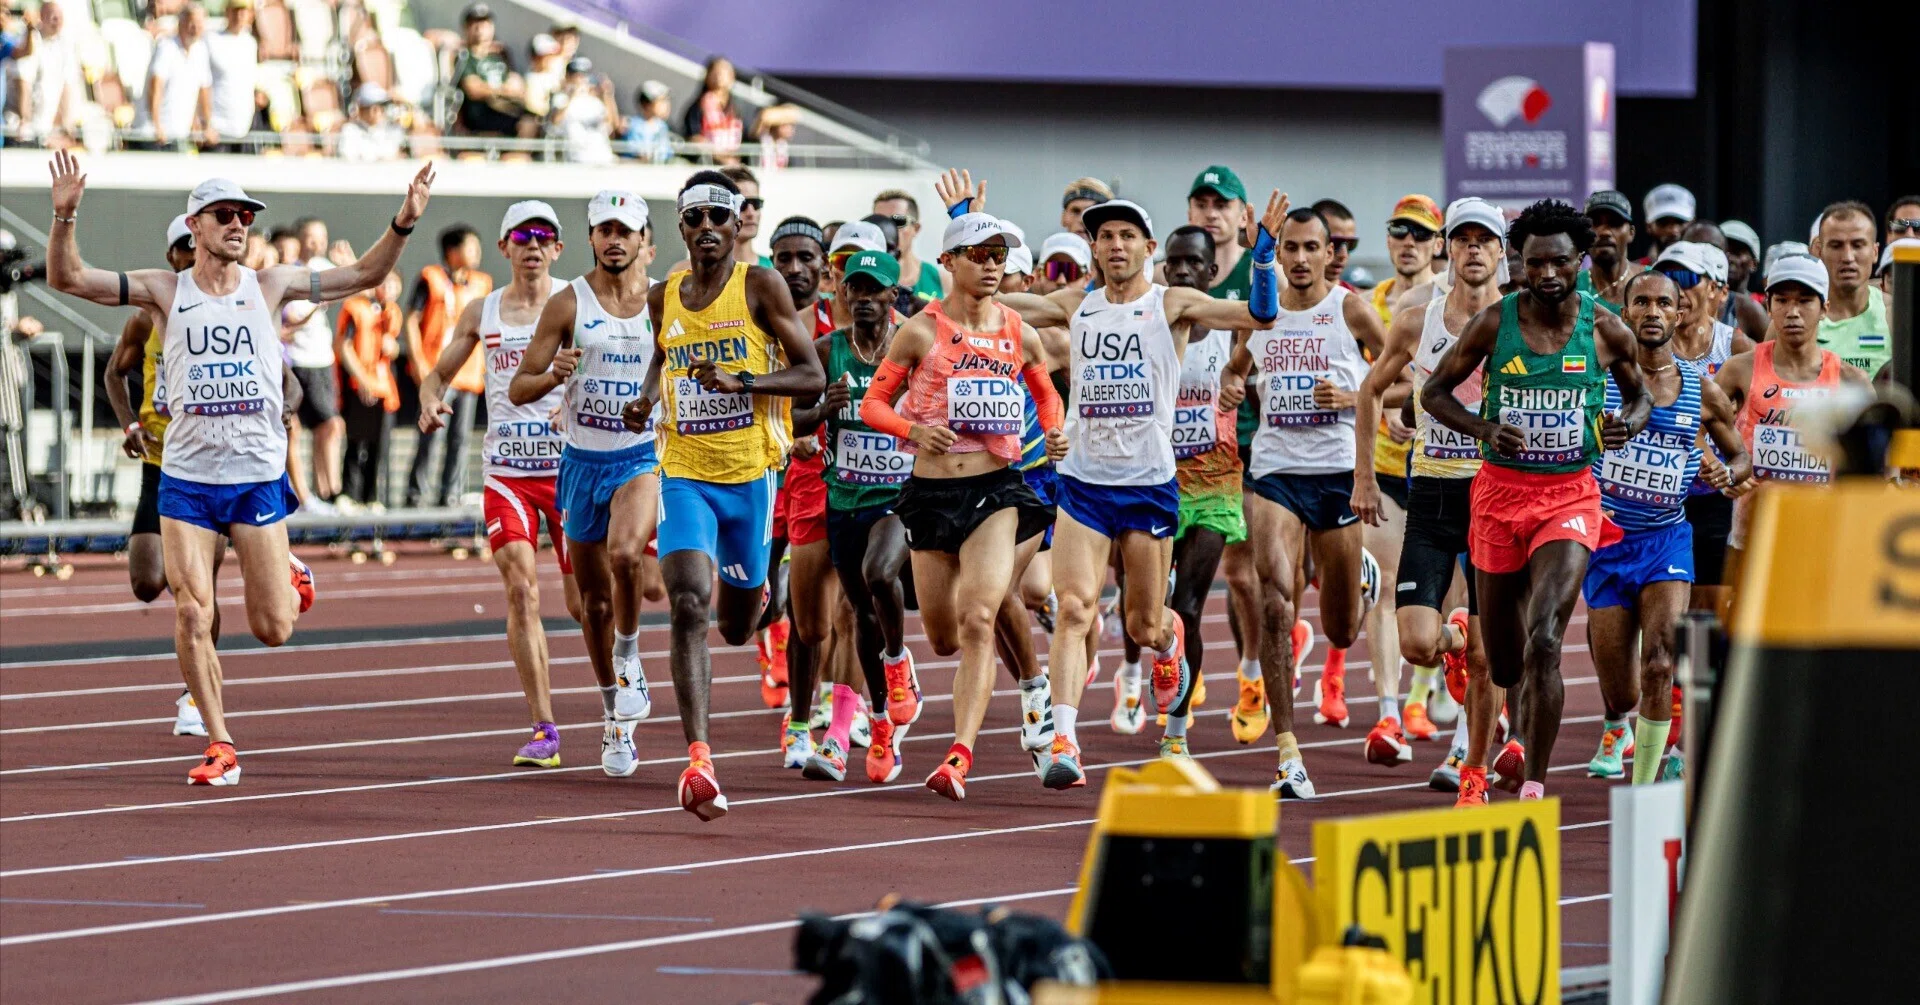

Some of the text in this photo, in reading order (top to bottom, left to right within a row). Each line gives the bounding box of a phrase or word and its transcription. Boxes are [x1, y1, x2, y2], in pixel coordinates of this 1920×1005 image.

[860, 256, 877, 267] IRL
[709, 320, 744, 330] BAUHAUS
[186, 325, 254, 355] USA
[1081, 331, 1143, 361] USA
[1266, 338, 1325, 355] GREAT
[602, 353, 641, 363] ITALIA
[667, 336, 748, 371] SWEDEN
[202, 361, 254, 380] TDK
[953, 353, 1014, 376] JAPAN
[1095, 363, 1145, 381] TDK
[1264, 355, 1329, 372] BRITAIN
[188, 380, 259, 401] YOUNG
[971, 380, 1019, 396] TDK
[1081, 382, 1150, 402] ALBERTSON
[1500, 385, 1587, 410] ETHIOPIA
[954, 401, 1020, 419] KONDO
[1174, 408, 1208, 424] DK
[1523, 411, 1577, 428] TDK
[1170, 426, 1211, 444] OZA
[1526, 429, 1579, 449] KELE
[1631, 429, 1685, 449] RAEL
[498, 440, 562, 457] GRUEN
[1443, 450, 1483, 459] TOKY
[1630, 445, 1681, 470] TDK
[511, 459, 559, 469] TOKYO2
[846, 451, 904, 471] HASO
[1758, 448, 1828, 471] YOSHIDA
[1608, 461, 1678, 492] TEFERI
